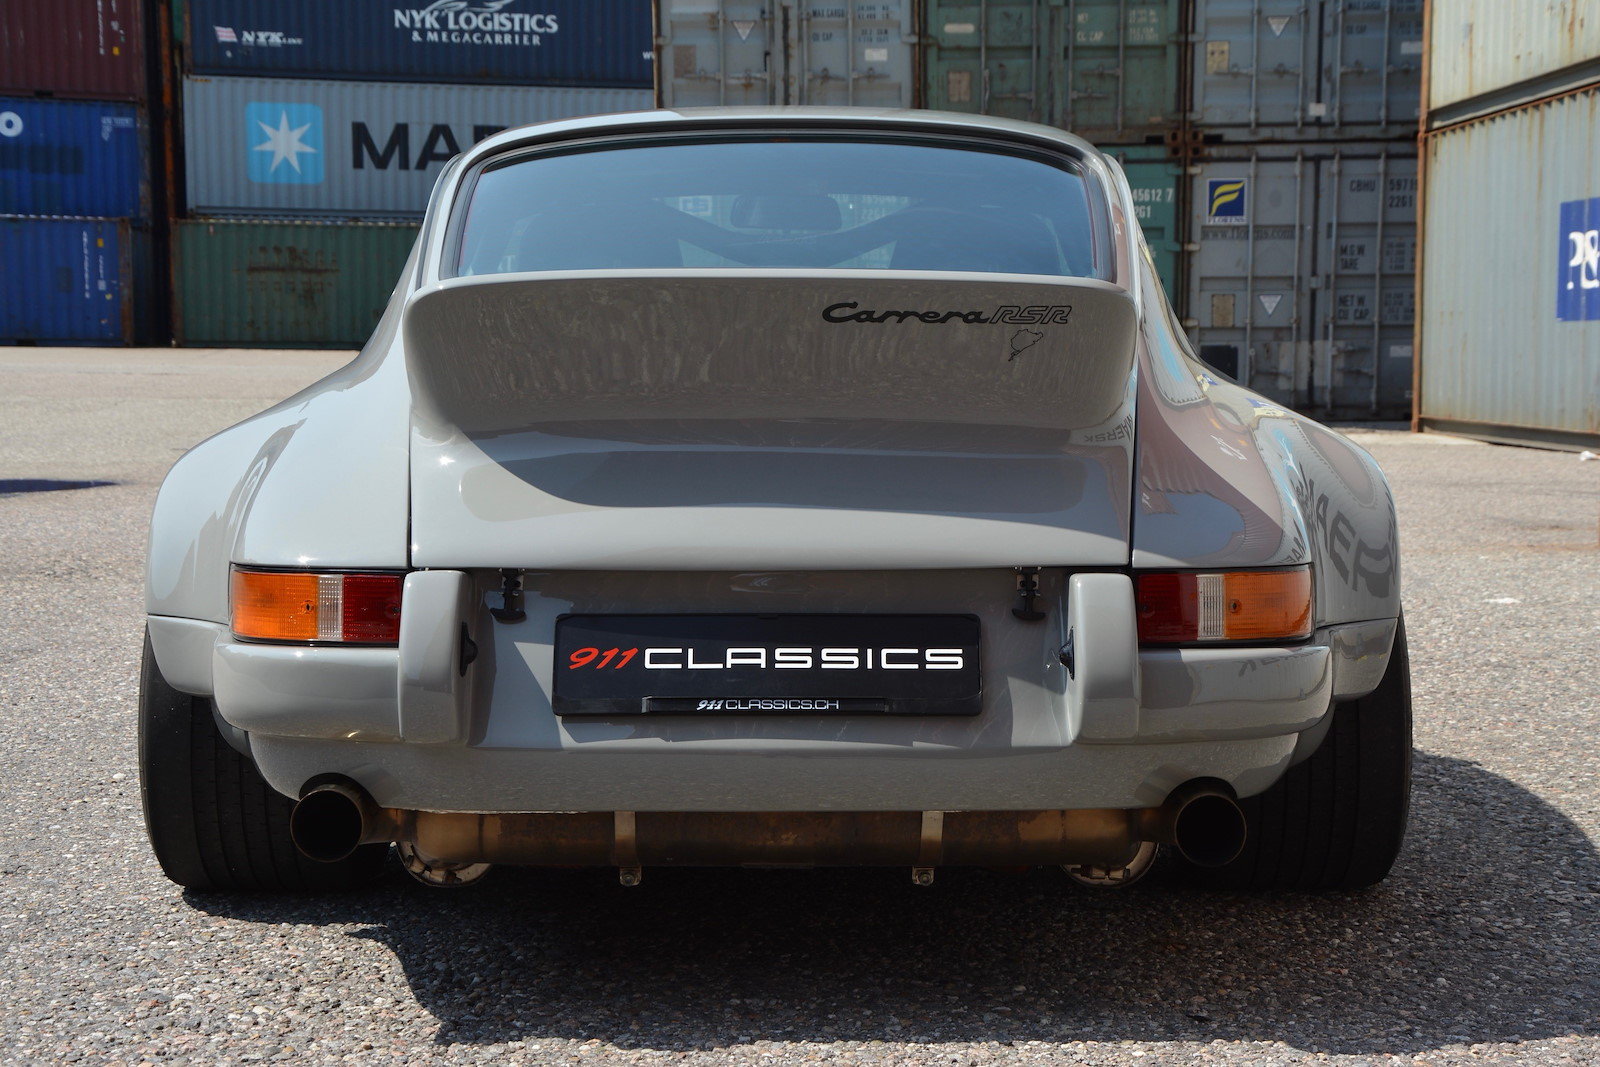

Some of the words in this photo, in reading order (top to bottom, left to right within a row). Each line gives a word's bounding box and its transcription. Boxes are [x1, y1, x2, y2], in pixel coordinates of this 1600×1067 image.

[394, 9, 441, 29] NYK
[448, 12, 559, 34] LOGISTICS
[242, 31, 284, 46] NYK
[412, 31, 422, 42] &
[427, 31, 541, 46] MEGACARRIER
[352, 121, 509, 170] MA
[822, 301, 990, 324] Carrera
[987, 305, 1072, 325] RSR
[569, 647, 639, 670] 911
[643, 647, 964, 670] CLASSICS
[725, 699, 840, 710] CLASSICS.CH
